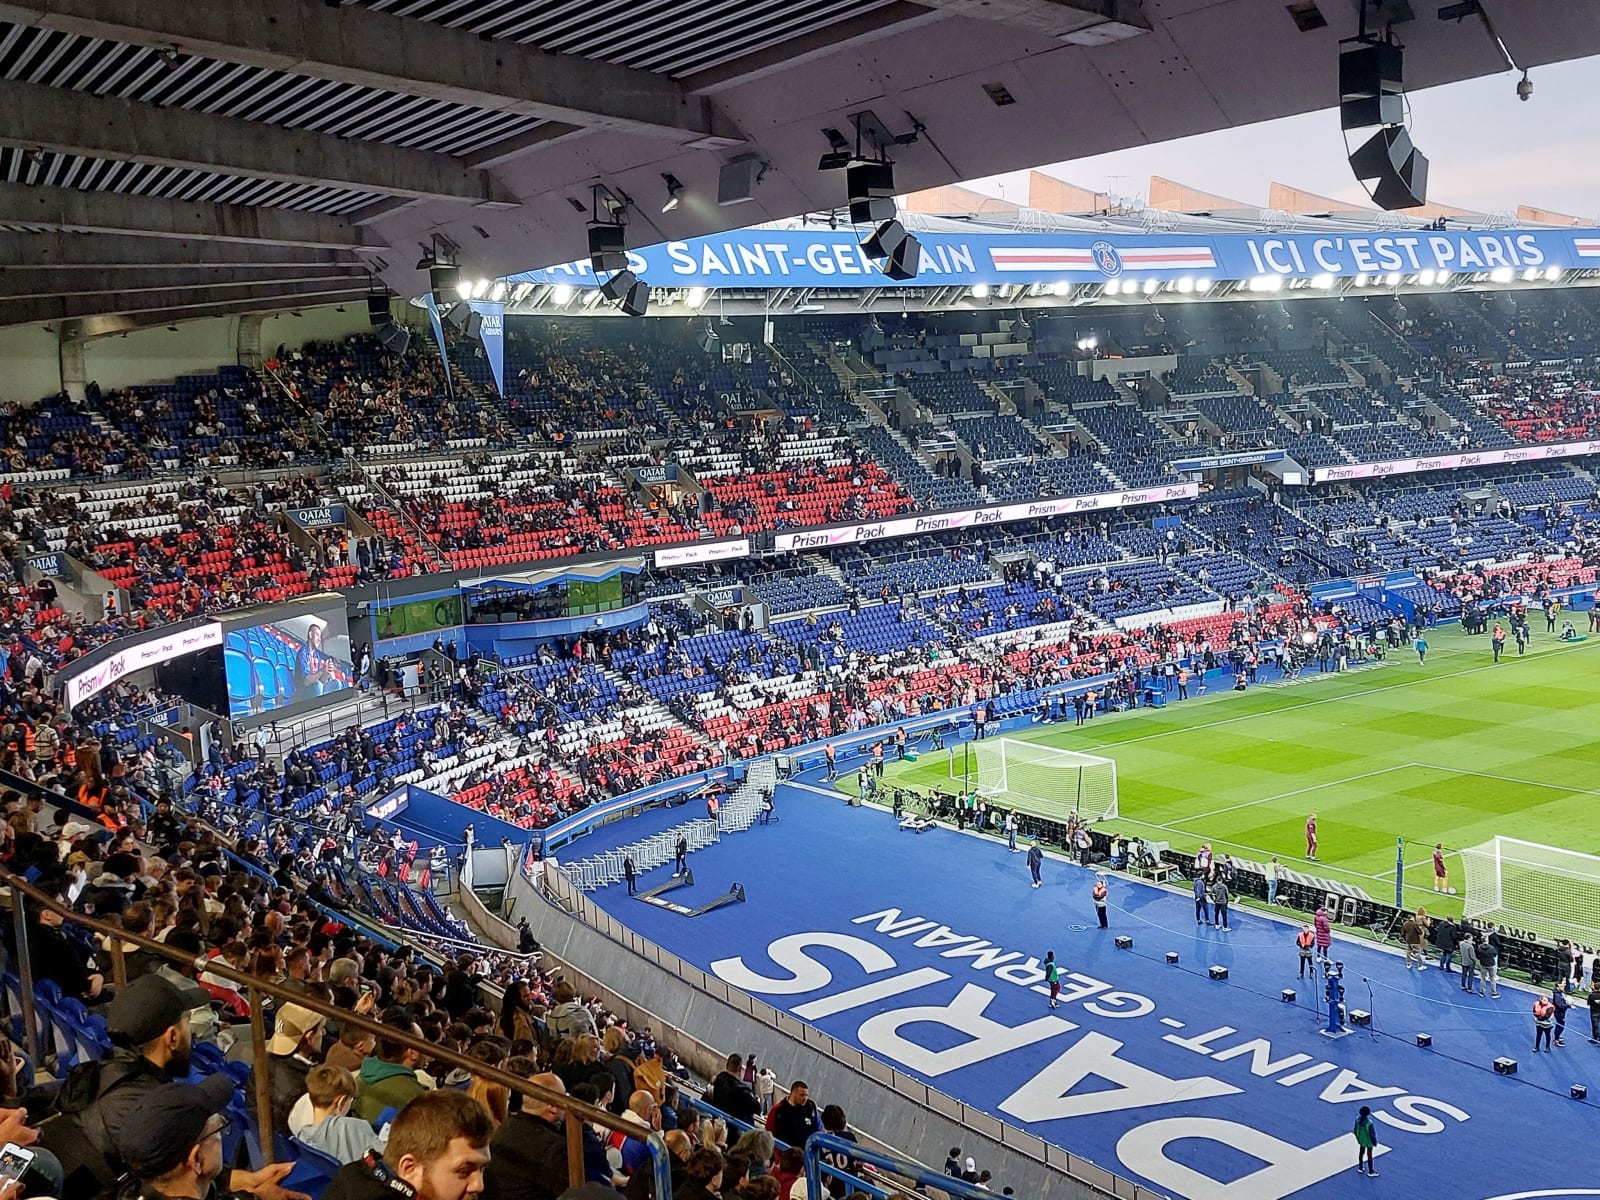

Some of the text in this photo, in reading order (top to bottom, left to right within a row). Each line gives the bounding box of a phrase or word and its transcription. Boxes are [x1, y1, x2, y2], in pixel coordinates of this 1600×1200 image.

[666, 241, 976, 275] SAINT-GERAIN
[1247, 233, 1545, 274] ICI C'EST PARIS
[481, 315, 502, 329] ATAR
[1415, 454, 1481, 470] Prism Pack
[1503, 447, 1567, 460] Prism Pack
[640, 467, 665, 479] QATAR
[1326, 463, 1395, 479] Prism Pack
[1121, 486, 1187, 504] Prism Pack
[299, 508, 332, 523] QATAR
[1028, 497, 1099, 516] Prism Pack
[915, 508, 1003, 532] Prism Pack
[791, 524, 886, 548] Prism Pack
[707, 590, 734, 602] QATAR
[78, 655, 126, 699] Prism Pack
[850, 907, 1472, 1134] SAINT-GERMAIN
[710, 932, 1393, 1200] PARIS
